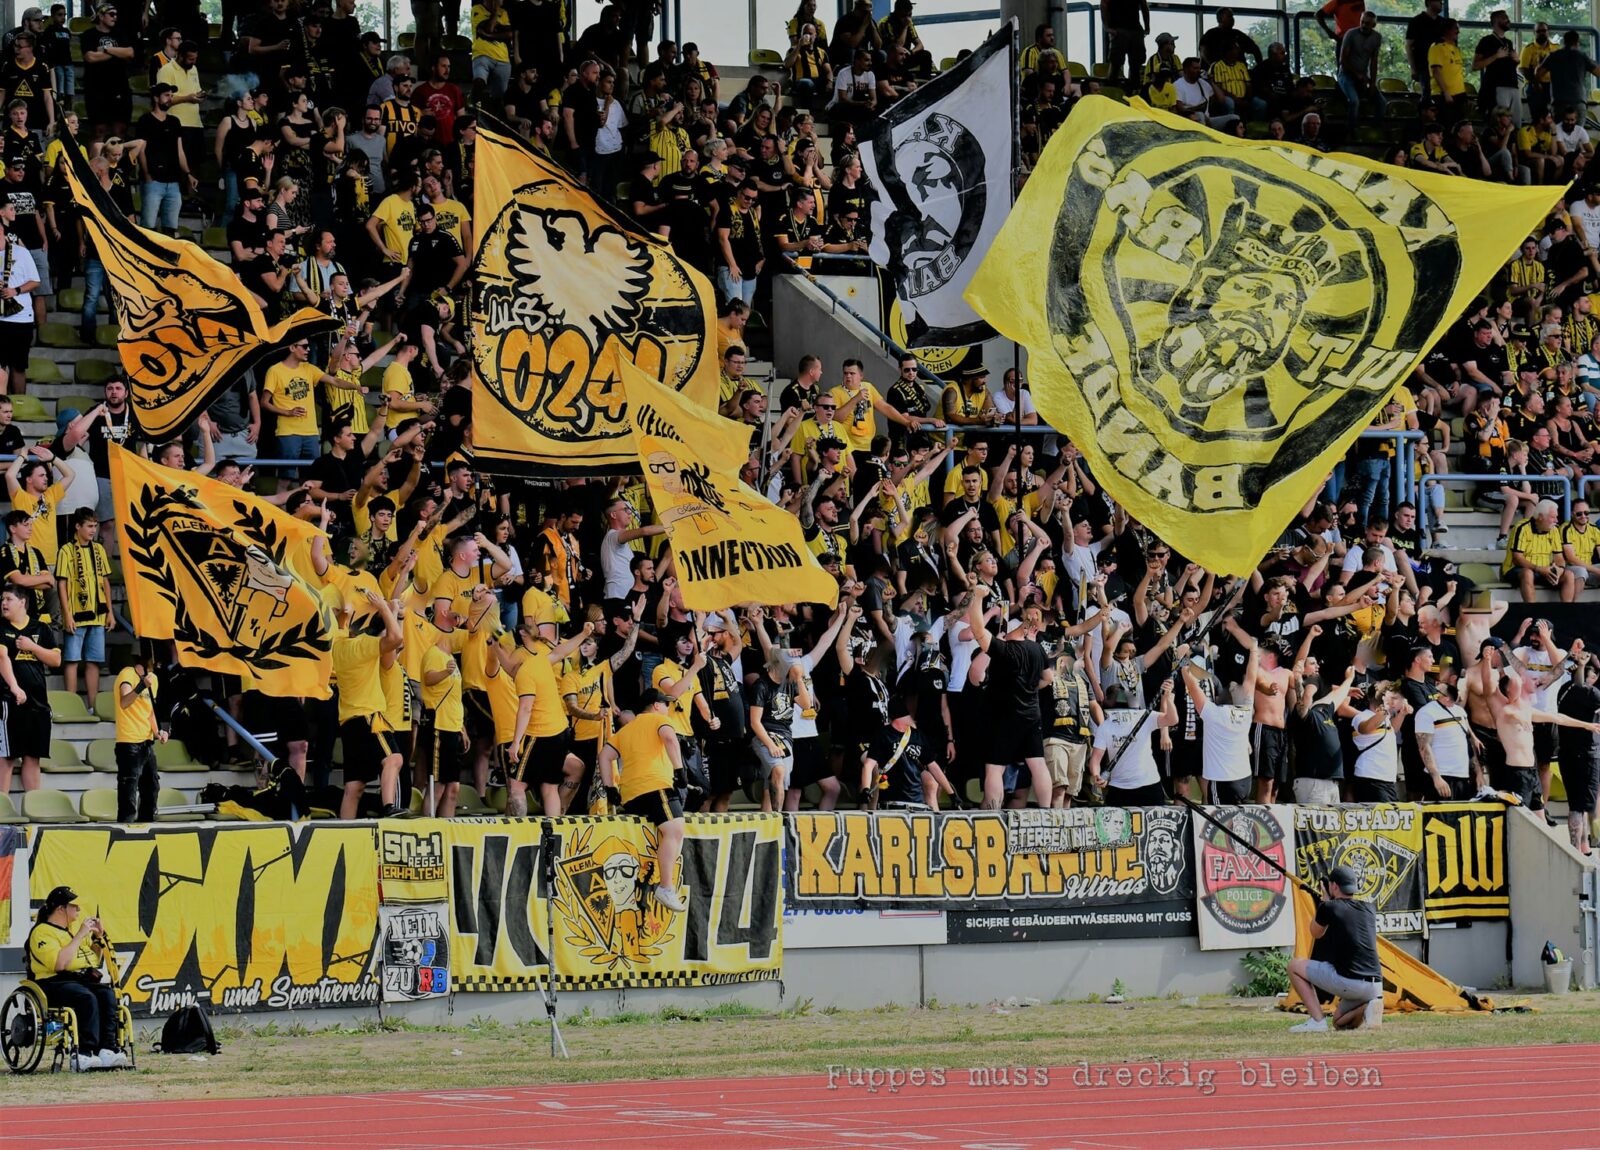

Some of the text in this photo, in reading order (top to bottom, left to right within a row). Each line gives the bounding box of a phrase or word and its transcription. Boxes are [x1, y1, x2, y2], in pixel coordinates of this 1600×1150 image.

[1344, 808, 1414, 832] STADT
[384, 866, 444, 880] ERHALTEN!
[408, 856, 443, 867] REGEL
[1208, 854, 1281, 880] FAXE
[1066, 874, 1148, 899] Ultras
[1226, 890, 1263, 901] POLICE
[388, 912, 440, 939] NEIN
[966, 911, 1192, 928] SICHERE GEBÄUDEENTWÄSSERUNG MIT GUSS
[1211, 902, 1280, 930] ALEMANNIA AACHEN
[224, 979, 262, 1008] und
[268, 975, 379, 1009] Sportverein
[387, 967, 448, 993] ZU RB
